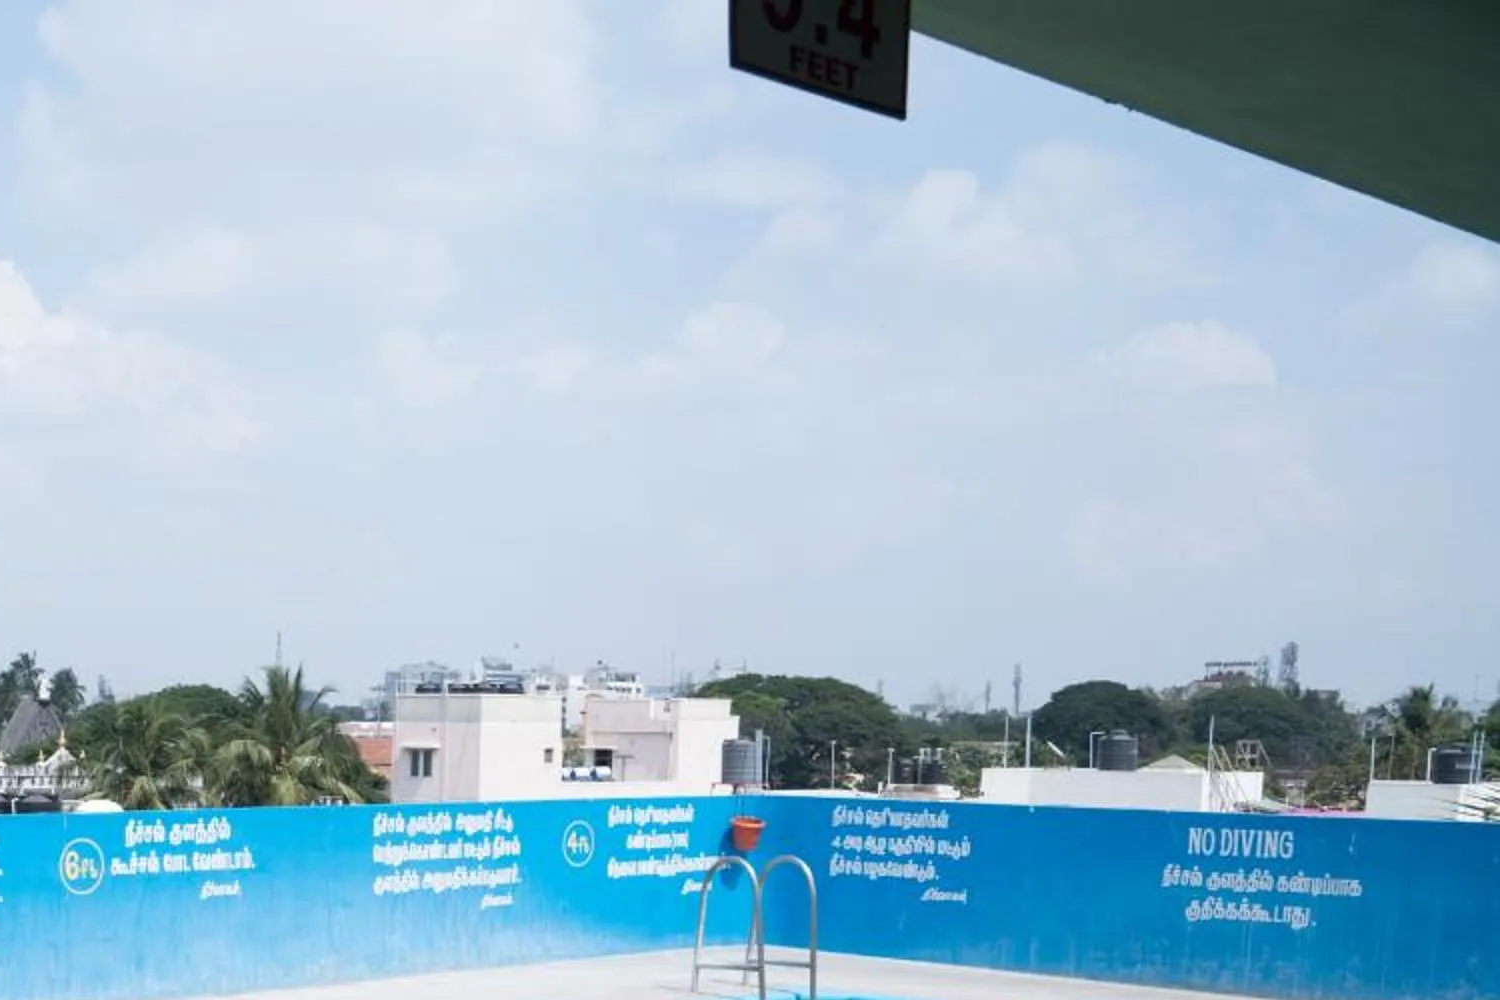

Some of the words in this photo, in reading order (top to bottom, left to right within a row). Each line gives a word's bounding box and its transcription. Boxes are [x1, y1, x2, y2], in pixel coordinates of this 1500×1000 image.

[788, 44, 860, 90] FEET
[125, 819, 165, 847] நீச்சல்
[169, 817, 231, 845] குளத்தில்
[1187, 827, 1215, 856] NO
[1219, 828, 1295, 860] DIVING
[1160, 864, 1203, 888] நீச்சல்
[1206, 867, 1275, 893] குளத்தில்
[1276, 871, 1362, 897] கண்டிப்பாக
